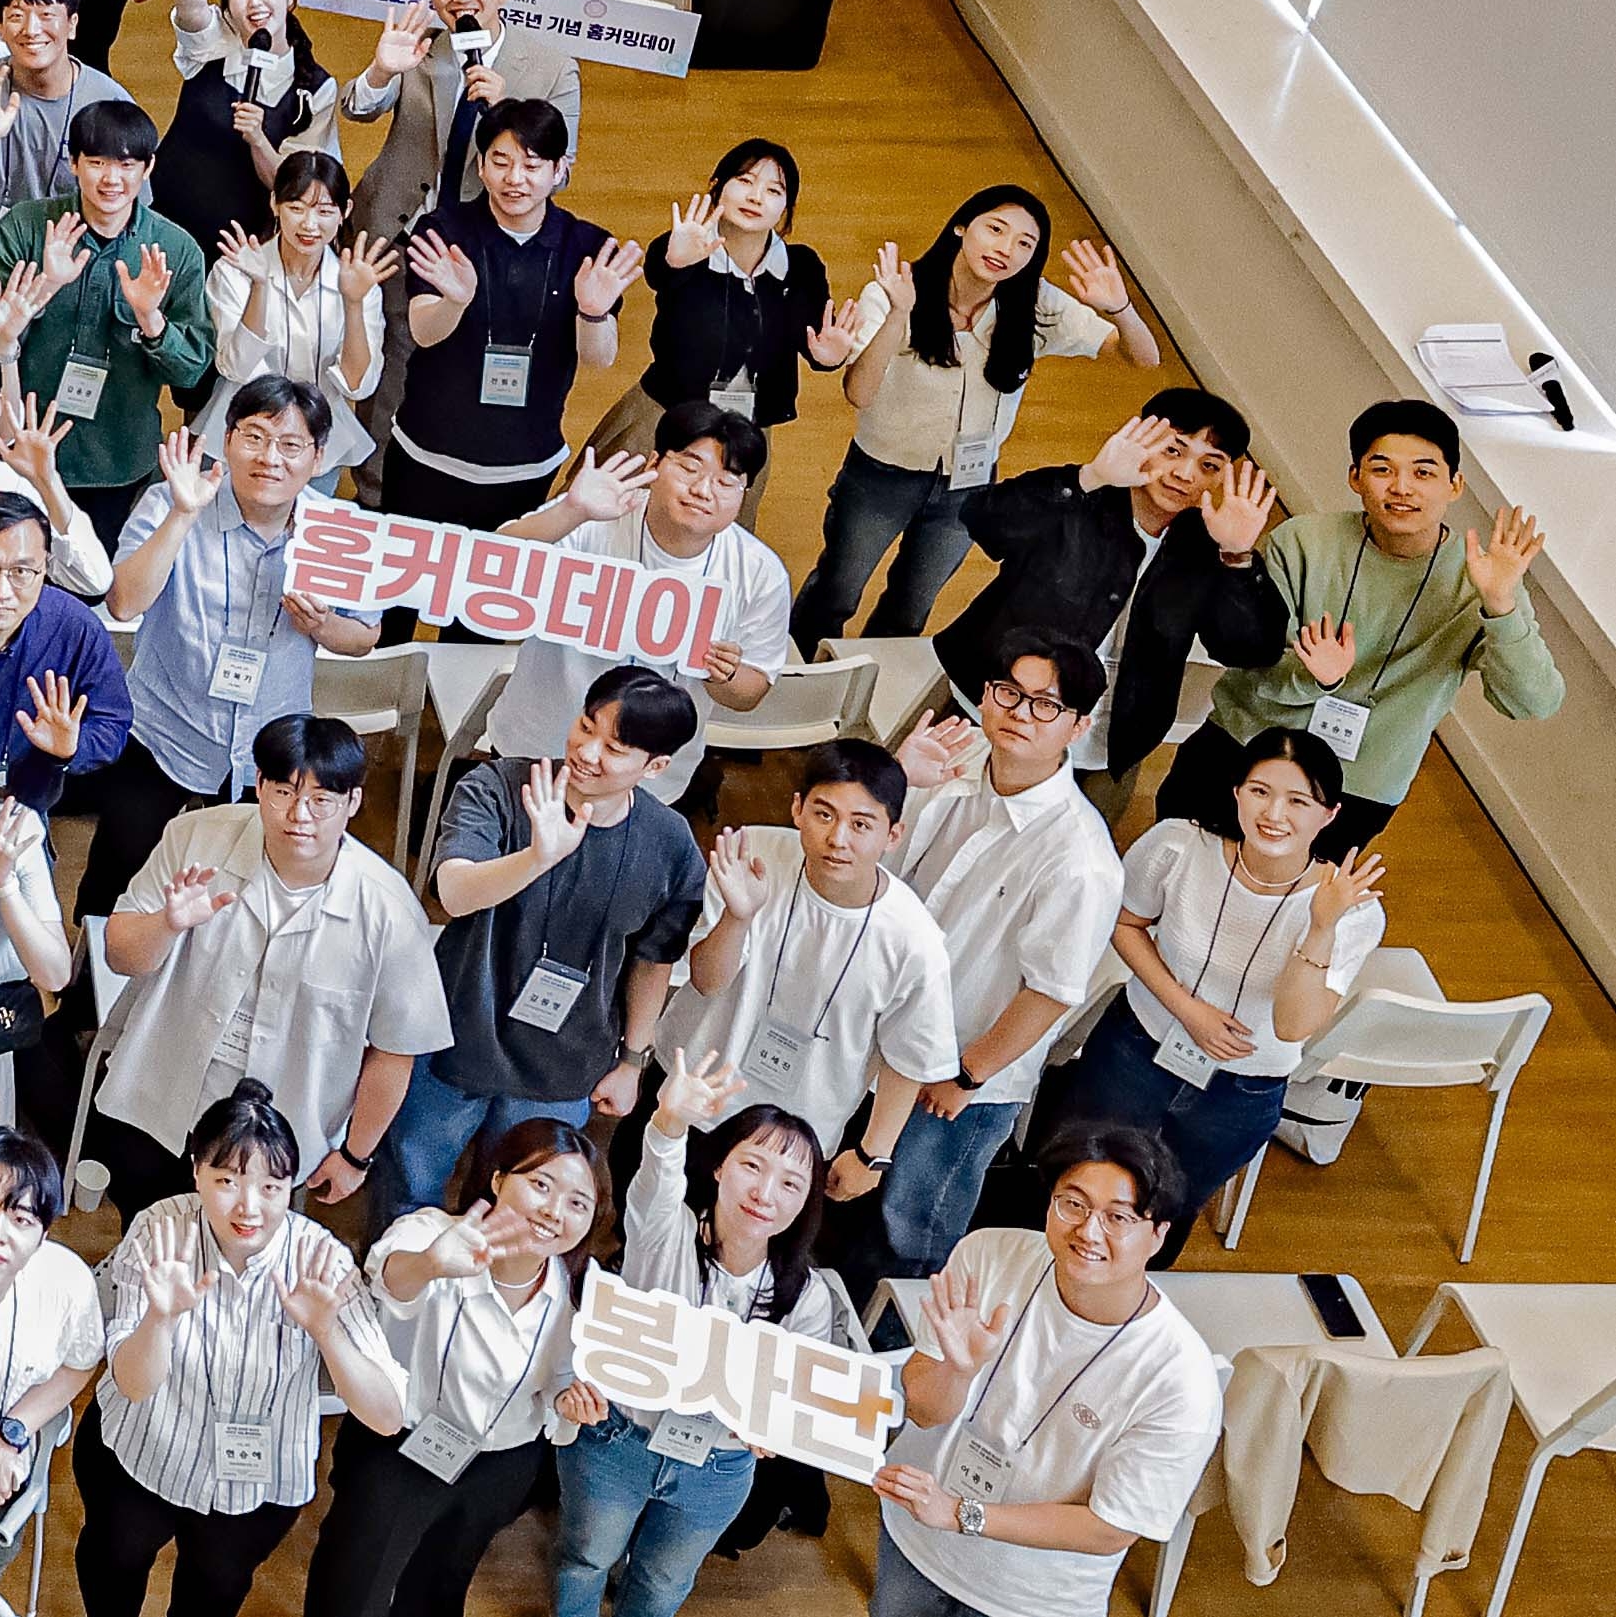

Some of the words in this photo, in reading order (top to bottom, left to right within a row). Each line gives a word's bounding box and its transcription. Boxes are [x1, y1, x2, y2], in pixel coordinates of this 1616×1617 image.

[498, 7, 542, 31] 0주년
[548, 17, 582, 38] 기념
[586, 23, 676, 55] 홈커밍데이
[292, 506, 722, 671] 홈커밍데이
[583, 1279, 895, 1471] 봉사단
